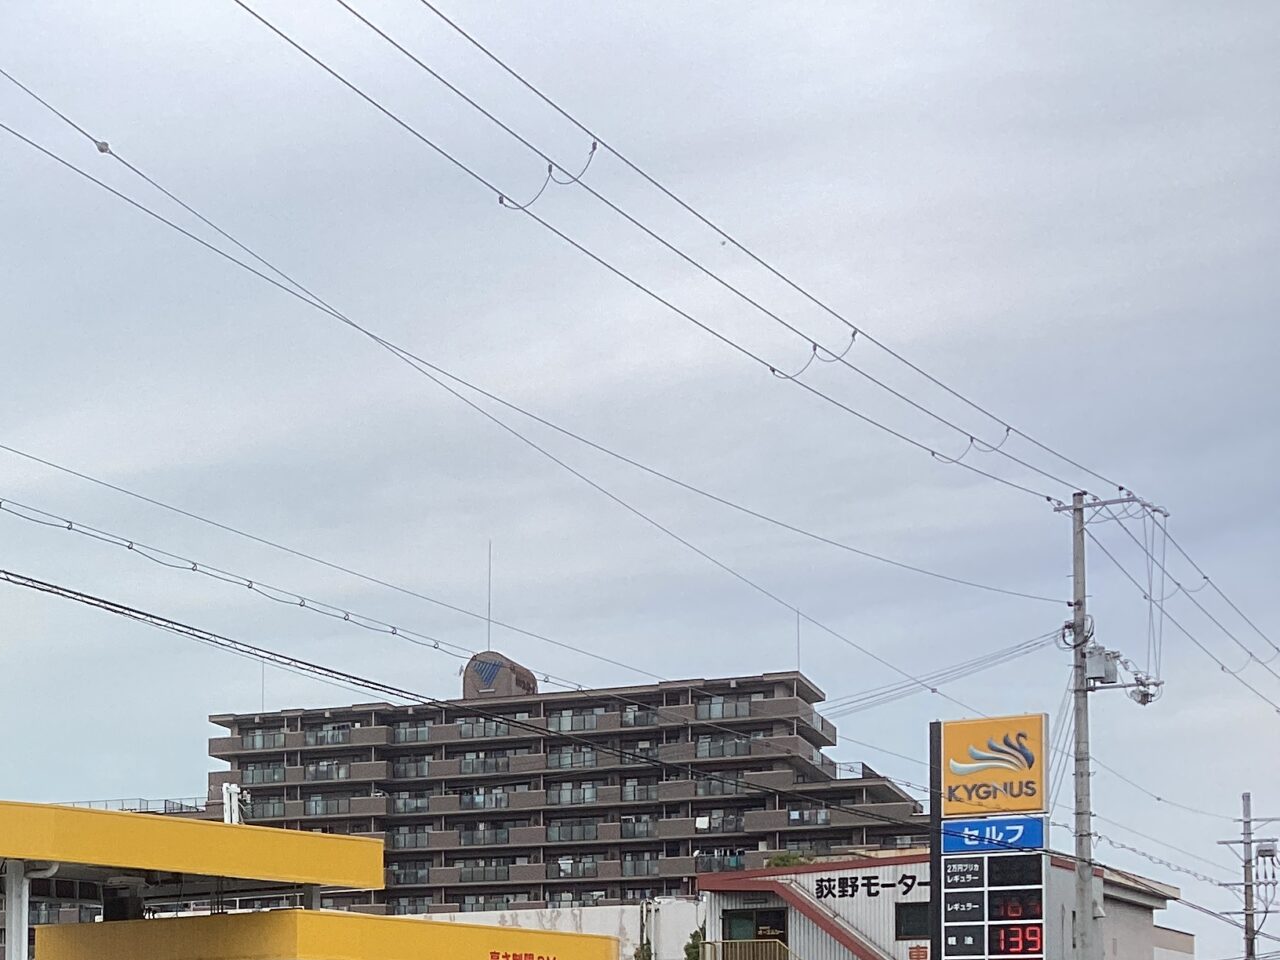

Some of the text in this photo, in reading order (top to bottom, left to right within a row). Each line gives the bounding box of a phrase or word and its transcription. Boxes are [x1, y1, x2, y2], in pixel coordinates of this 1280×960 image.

[947, 780, 1037, 802] KYGNUS
[962, 825, 1025, 845] セルフ
[946, 874, 979, 883] レギュラー
[946, 902, 980, 912] レギュラー
[1000, 926, 1041, 952] 139
